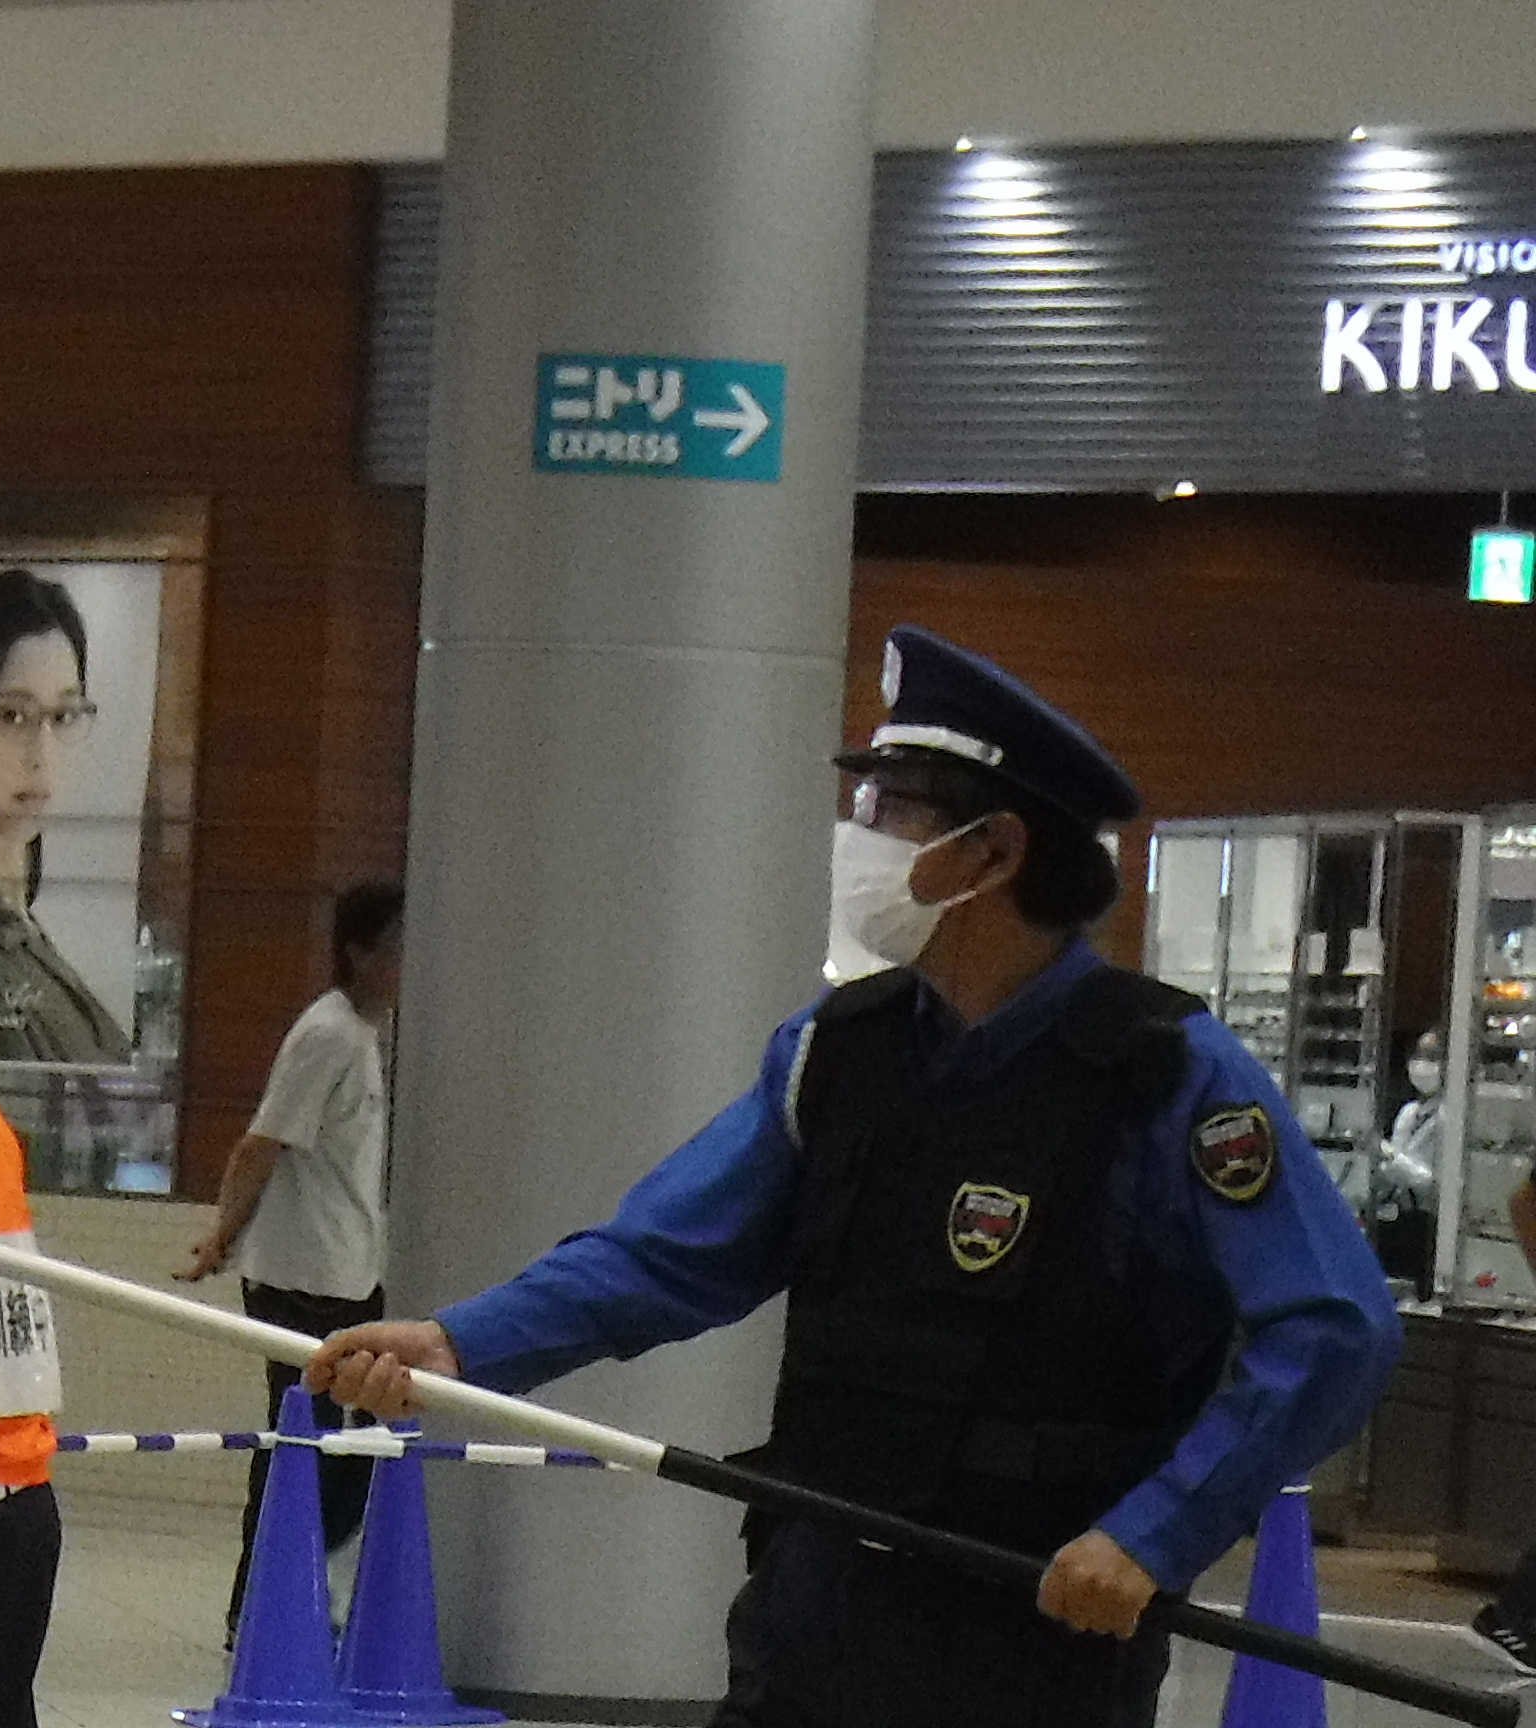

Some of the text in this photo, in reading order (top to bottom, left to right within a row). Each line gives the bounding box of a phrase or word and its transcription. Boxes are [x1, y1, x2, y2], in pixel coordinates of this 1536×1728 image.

[550, 365, 682, 422] ニトリ
[547, 429, 679, 464] EXPRESS
